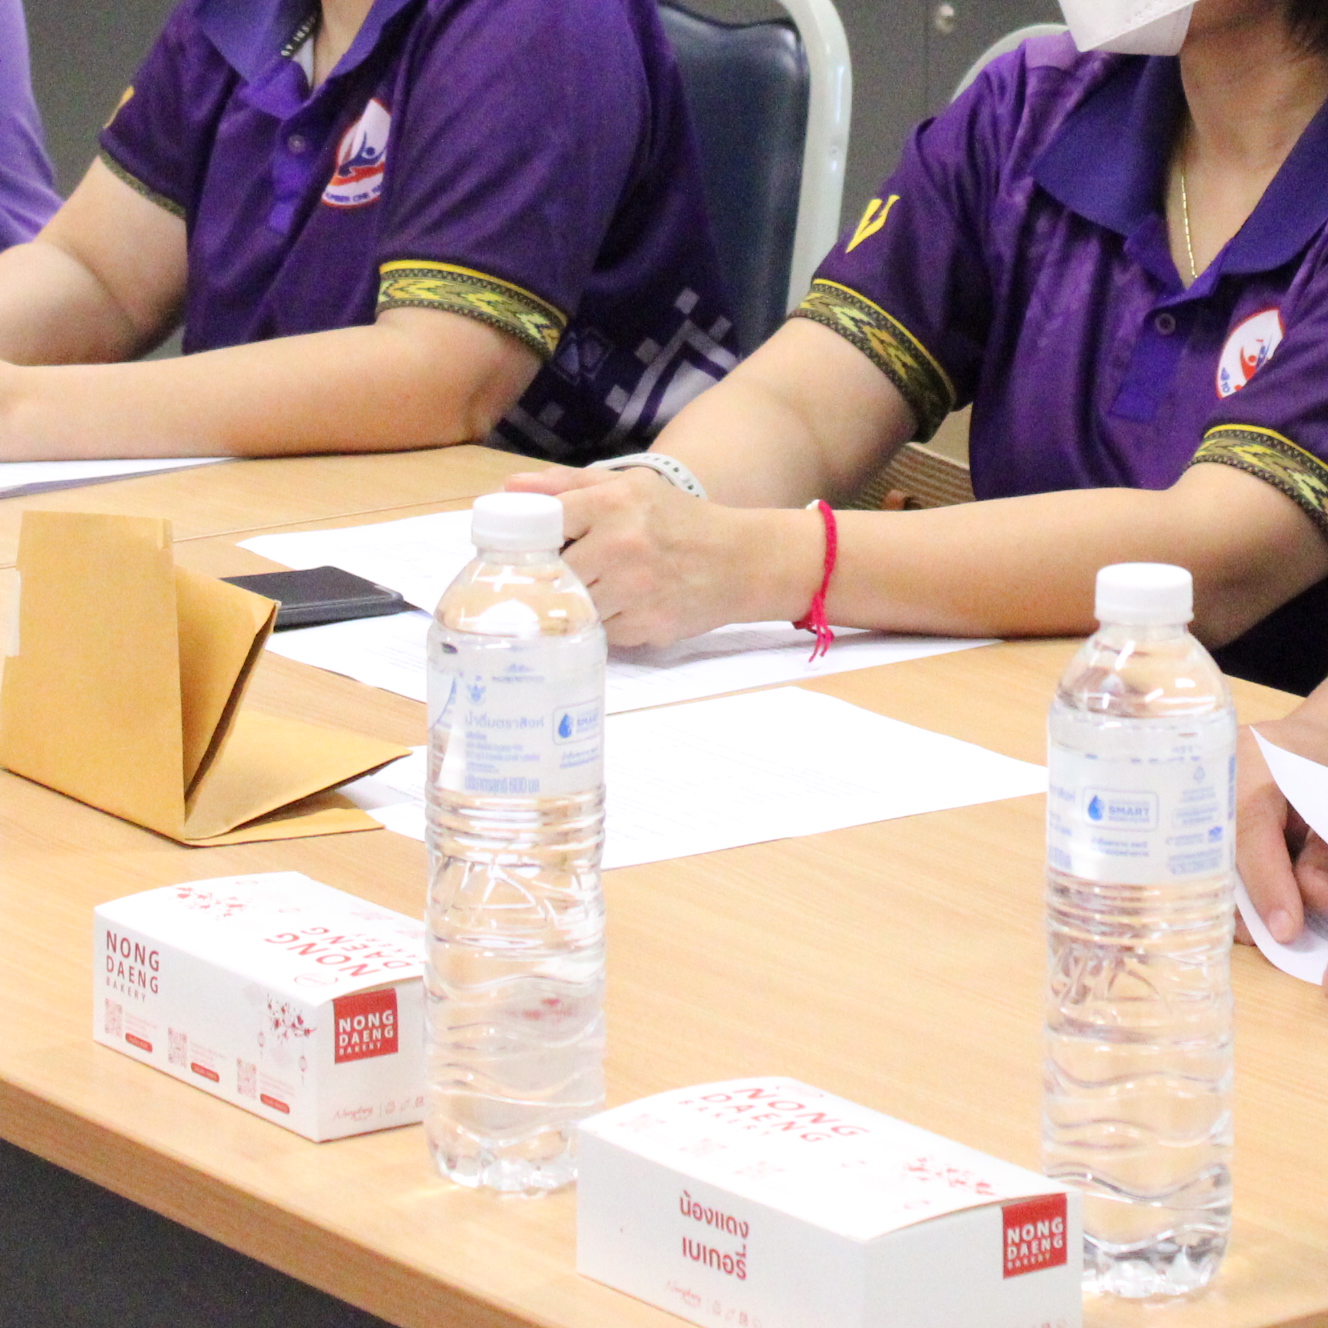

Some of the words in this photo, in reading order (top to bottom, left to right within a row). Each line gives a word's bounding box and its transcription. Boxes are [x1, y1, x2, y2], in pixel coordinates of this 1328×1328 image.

[106, 930, 160, 972] NONG
[264, 932, 381, 977] NONG
[300, 926, 413, 969] DAENG
[106, 954, 159, 994] DAENG
[106, 975, 146, 1003] BAKERY
[338, 1010, 394, 1033] NONG
[339, 1026, 394, 1047] DAENG
[700, 1093, 832, 1142] DAENG
[733, 1087, 871, 1136] NONG
[679, 1189, 750, 1239] น้องแดง
[1007, 1216, 1064, 1245] NONG
[682, 1236, 747, 1281] เบเกอรี่
[1007, 1234, 1064, 1261] DAENG
